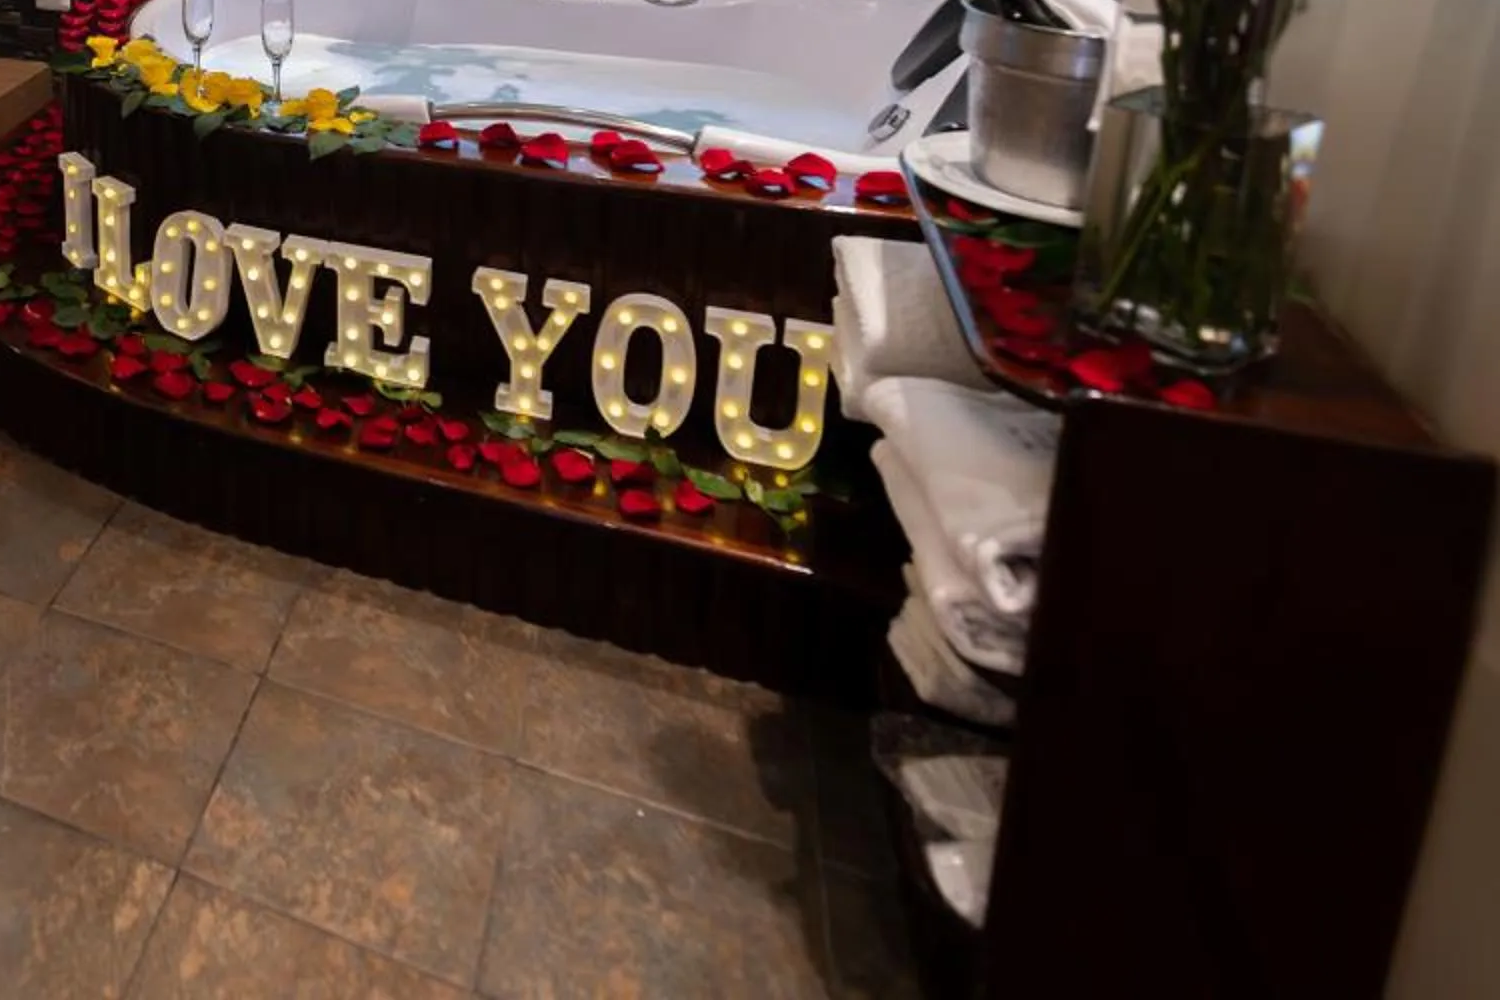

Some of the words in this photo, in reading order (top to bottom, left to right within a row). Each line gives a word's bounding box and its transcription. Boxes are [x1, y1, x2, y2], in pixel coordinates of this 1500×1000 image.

[58, 151, 96, 269] I
[94, 175, 432, 389] LOVE
[472, 266, 836, 470] YOU
